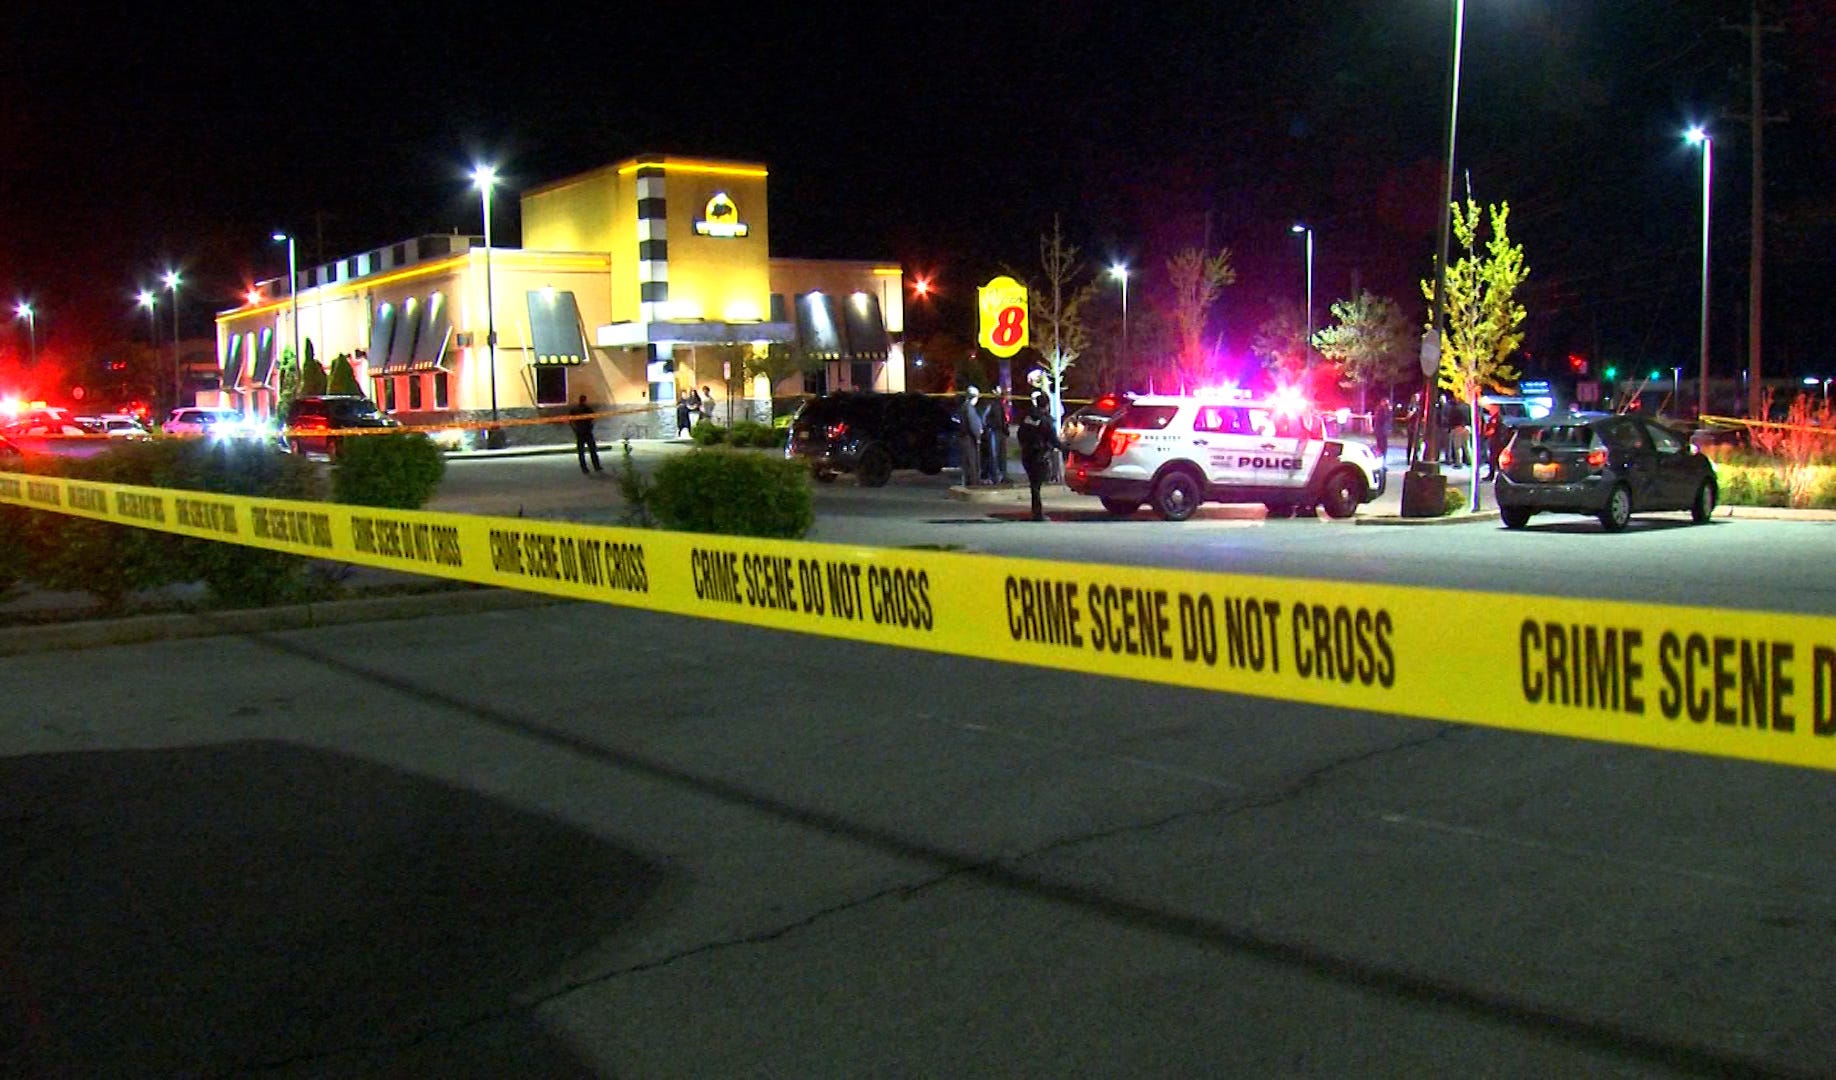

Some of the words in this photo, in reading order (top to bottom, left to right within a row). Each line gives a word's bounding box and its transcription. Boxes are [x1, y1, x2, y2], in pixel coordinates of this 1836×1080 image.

[992, 306, 1025, 347] 8
[1238, 457, 1303, 471] POLICE
[489, 528, 525, 575] CRIME
[523, 532, 561, 581] SCENE
[560, 537, 579, 584] DO
[577, 538, 604, 587] NOT
[604, 540, 649, 594] CROSS
[691, 547, 742, 604] CRIME
[743, 552, 798, 612] SCENE
[798, 558, 825, 617] DO
[826, 561, 864, 622] NOT
[867, 564, 934, 632] CROSS
[1005, 575, 1083, 649] CRIME
[1088, 583, 1173, 660] SCENE
[1179, 592, 1218, 667] DO
[1225, 596, 1281, 674] NOT
[1292, 602, 1396, 690] CROSS
[1520, 619, 1646, 716] CRIME
[1659, 630, 1796, 733] SCENE
